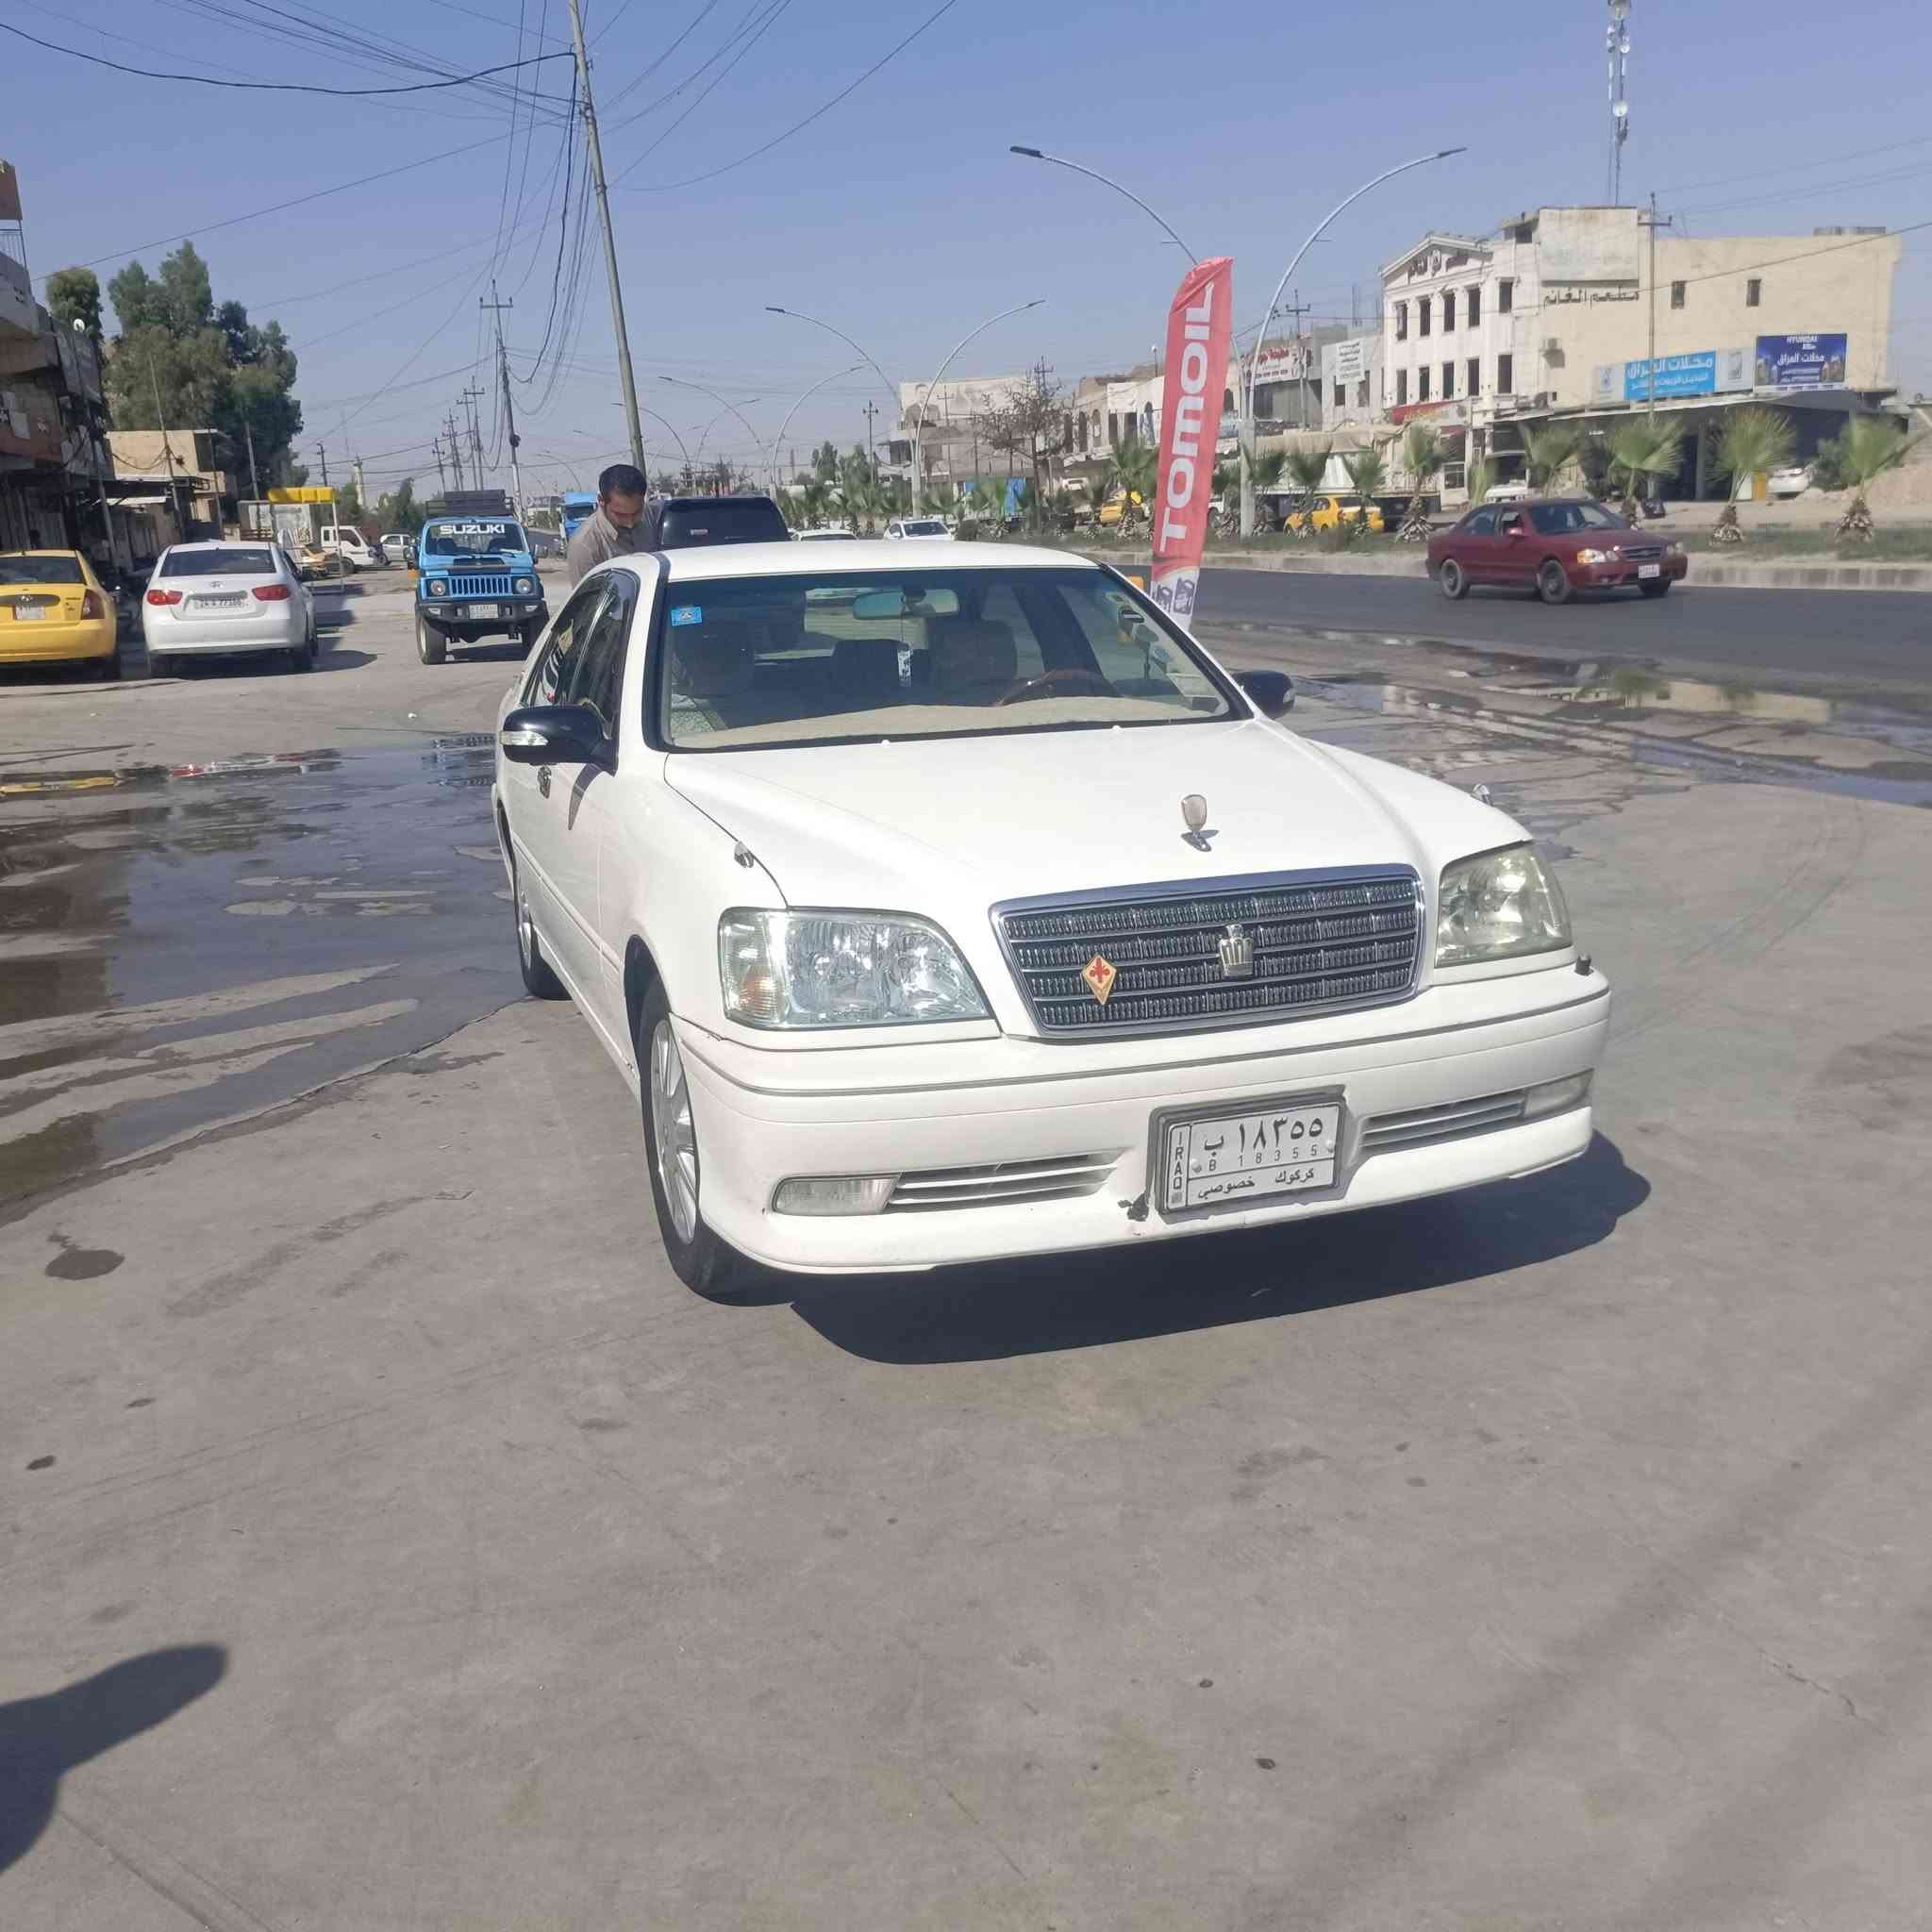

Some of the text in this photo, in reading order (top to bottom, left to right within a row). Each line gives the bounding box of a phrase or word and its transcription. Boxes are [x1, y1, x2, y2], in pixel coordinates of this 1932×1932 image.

[440, 524, 505, 535] SUZUKI
[1238, 1117, 1324, 1152] ١٨٣٥٥
[1173, 1131, 1184, 1190] IRAQ
[1238, 1142, 1318, 1167] 18355
[1197, 1168, 1314, 1200] كركوك خصوصي
